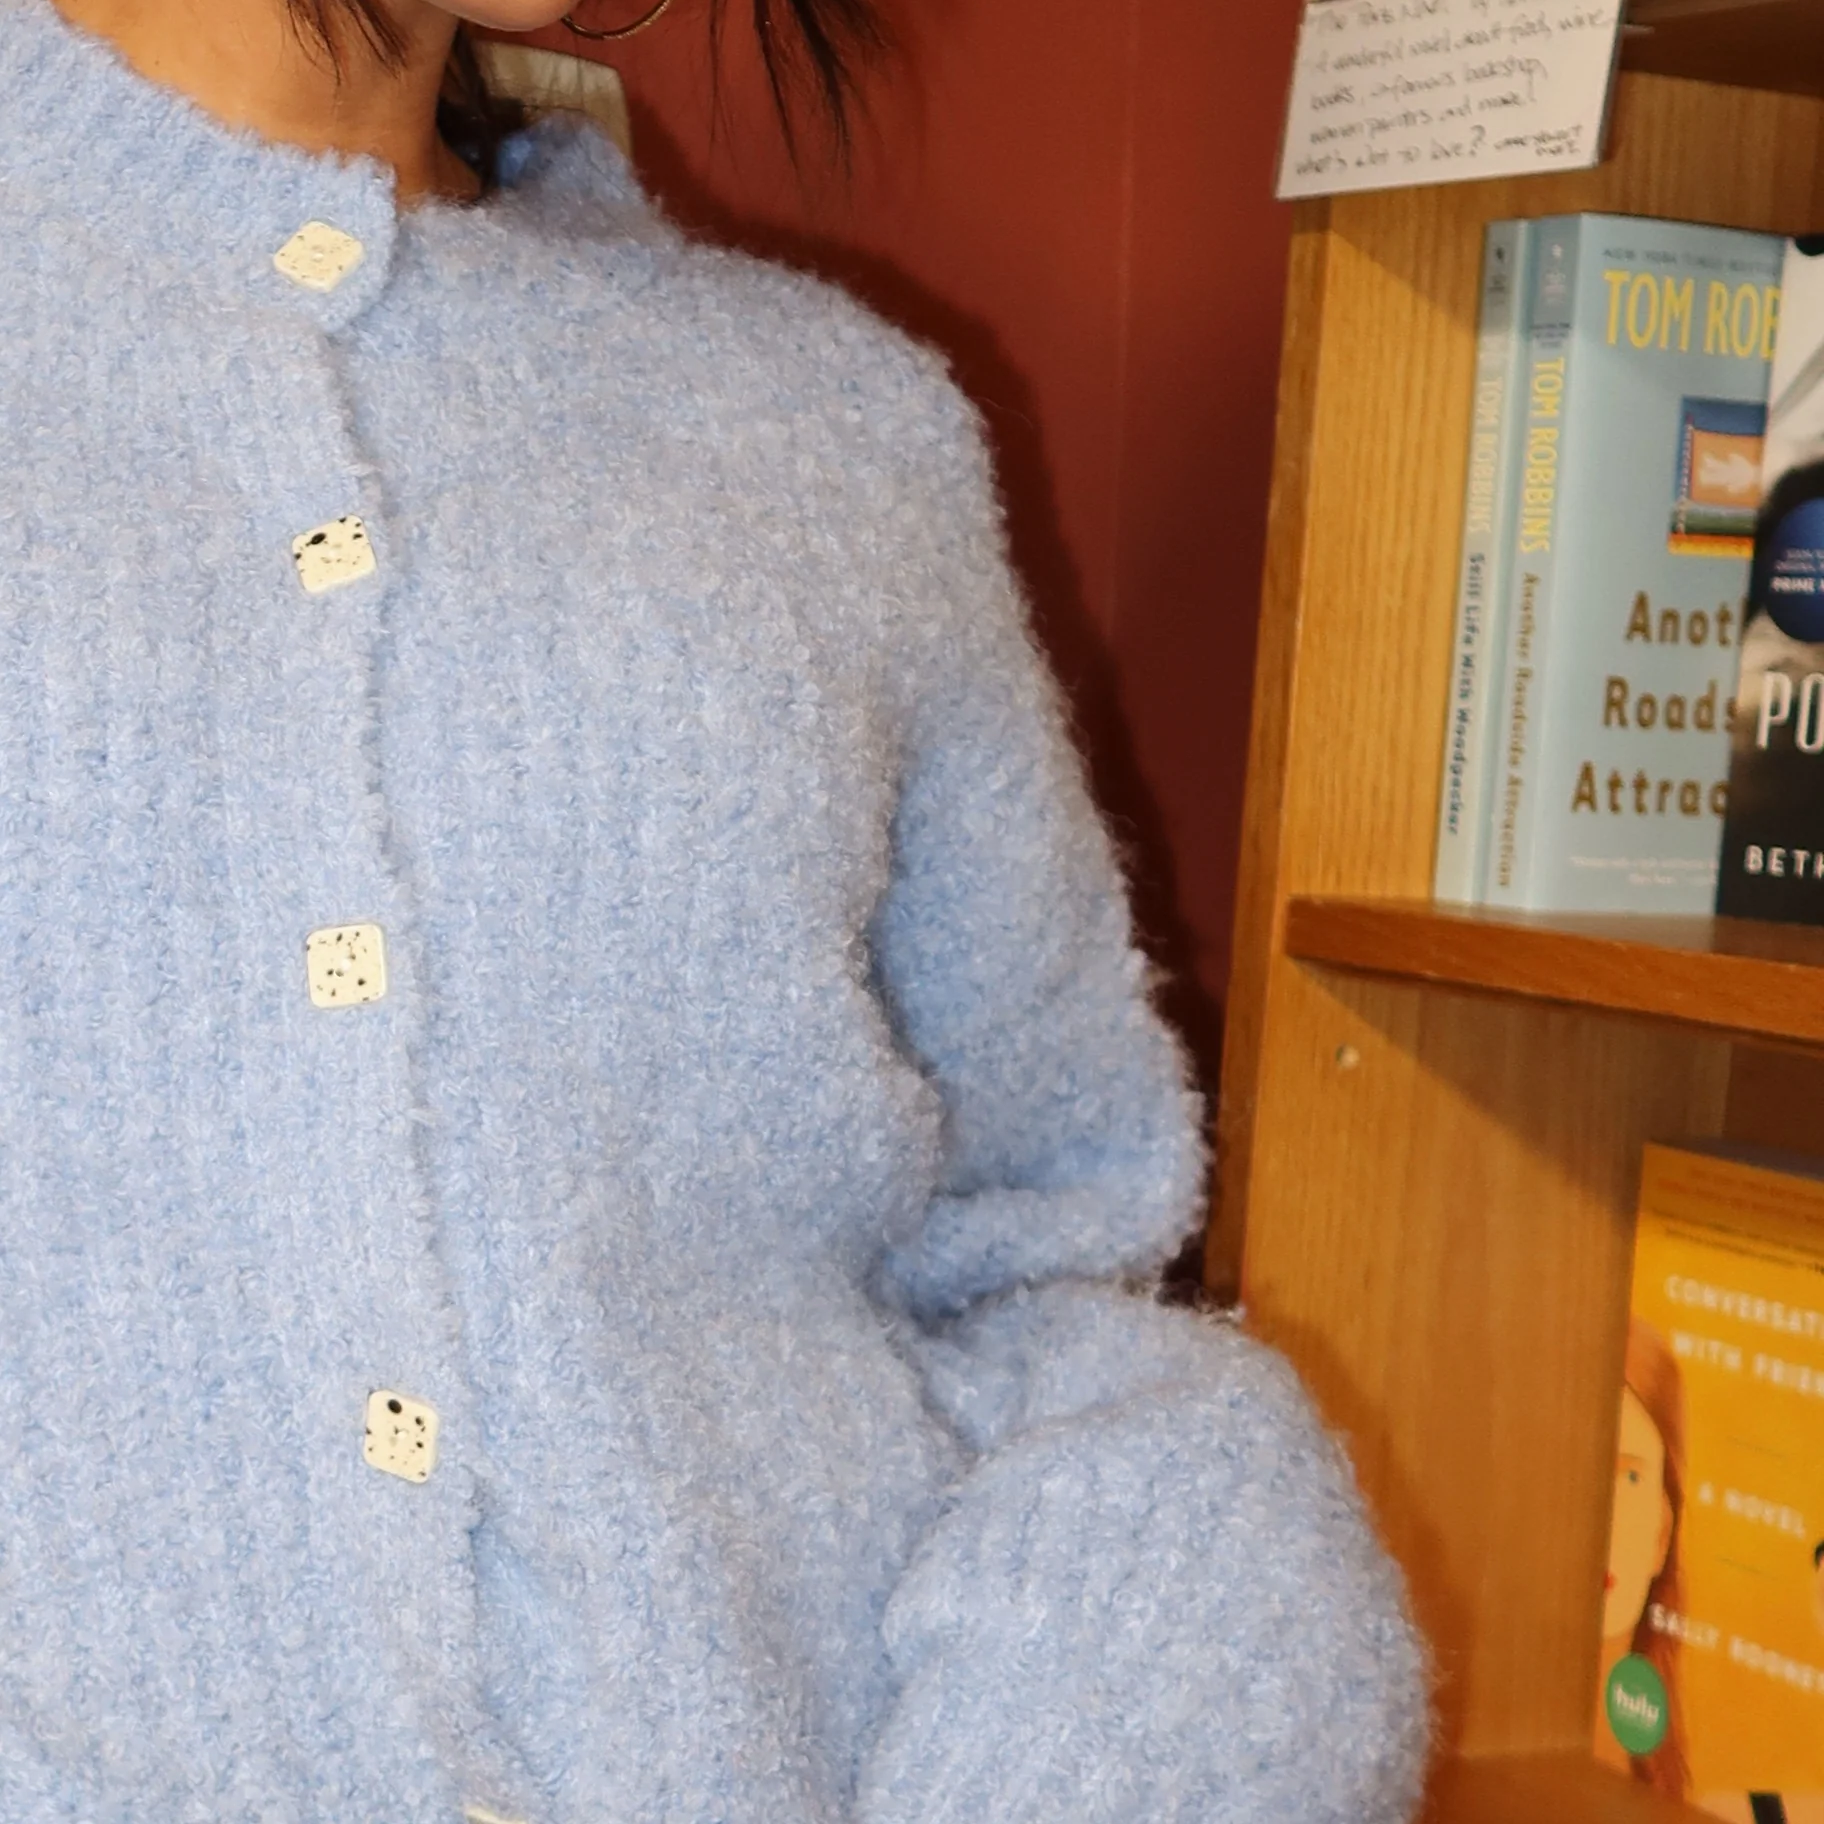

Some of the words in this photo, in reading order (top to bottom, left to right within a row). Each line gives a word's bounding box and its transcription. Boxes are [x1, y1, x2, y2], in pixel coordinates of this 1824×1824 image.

[1603, 269, 1693, 353] TOM
[1533, 358, 1565, 419] TOM
[1521, 426, 1559, 553] ROBBINS
